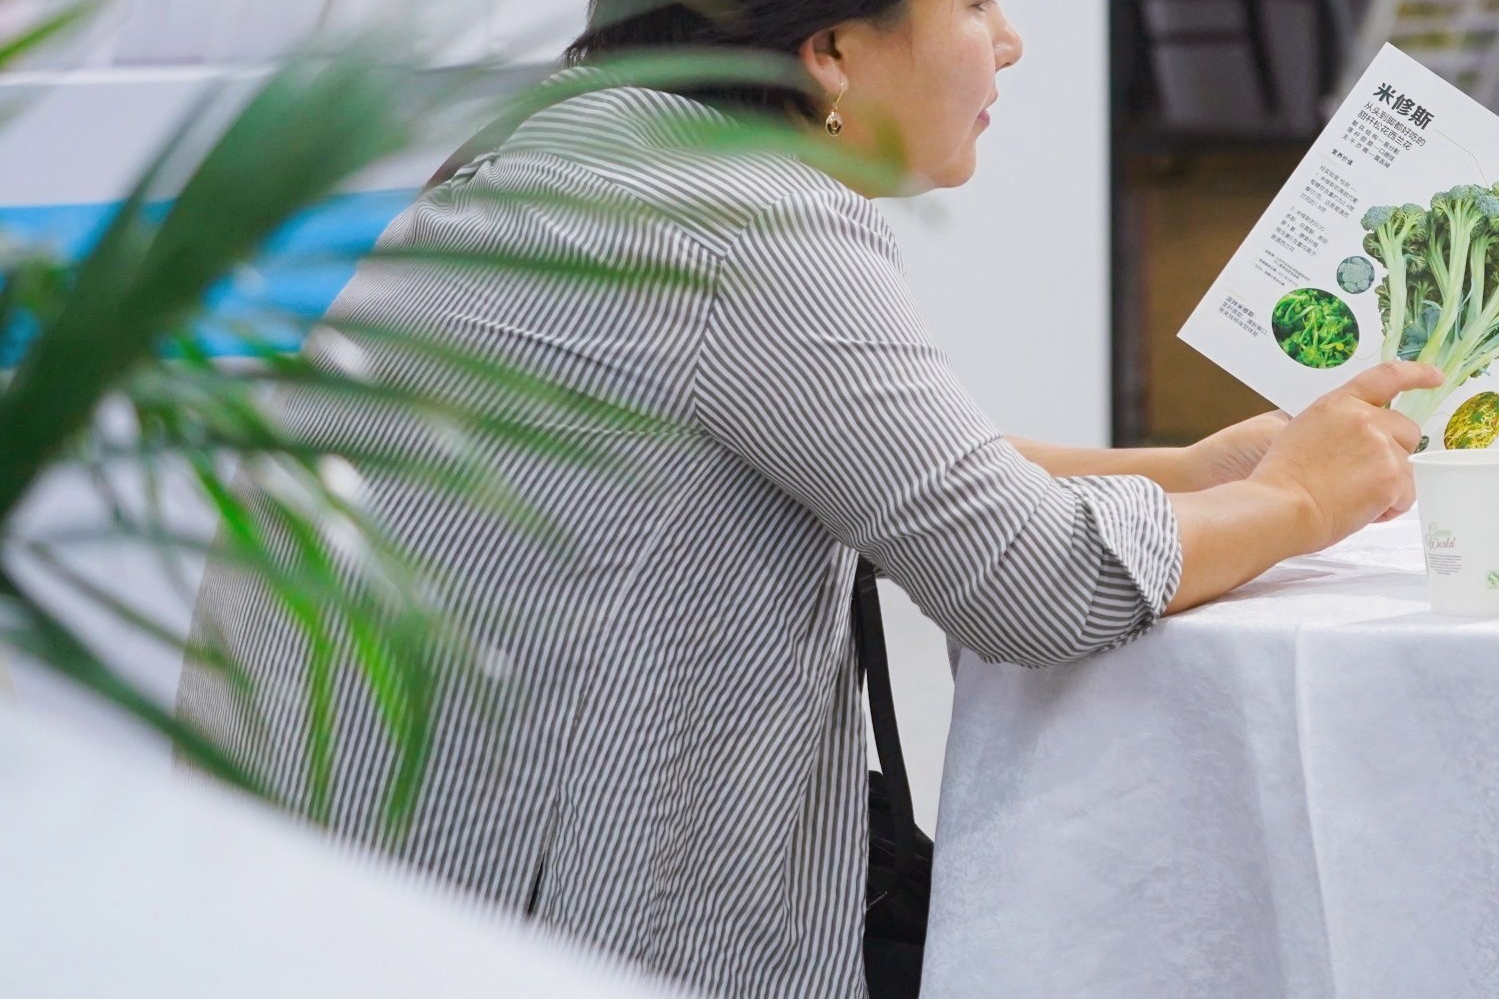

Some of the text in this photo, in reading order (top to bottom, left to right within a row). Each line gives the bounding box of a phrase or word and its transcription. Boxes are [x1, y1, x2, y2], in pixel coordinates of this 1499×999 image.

[1364, 101, 1426, 146] 从头到脚都好吃的
[1373, 83, 1434, 130] 米修斯
